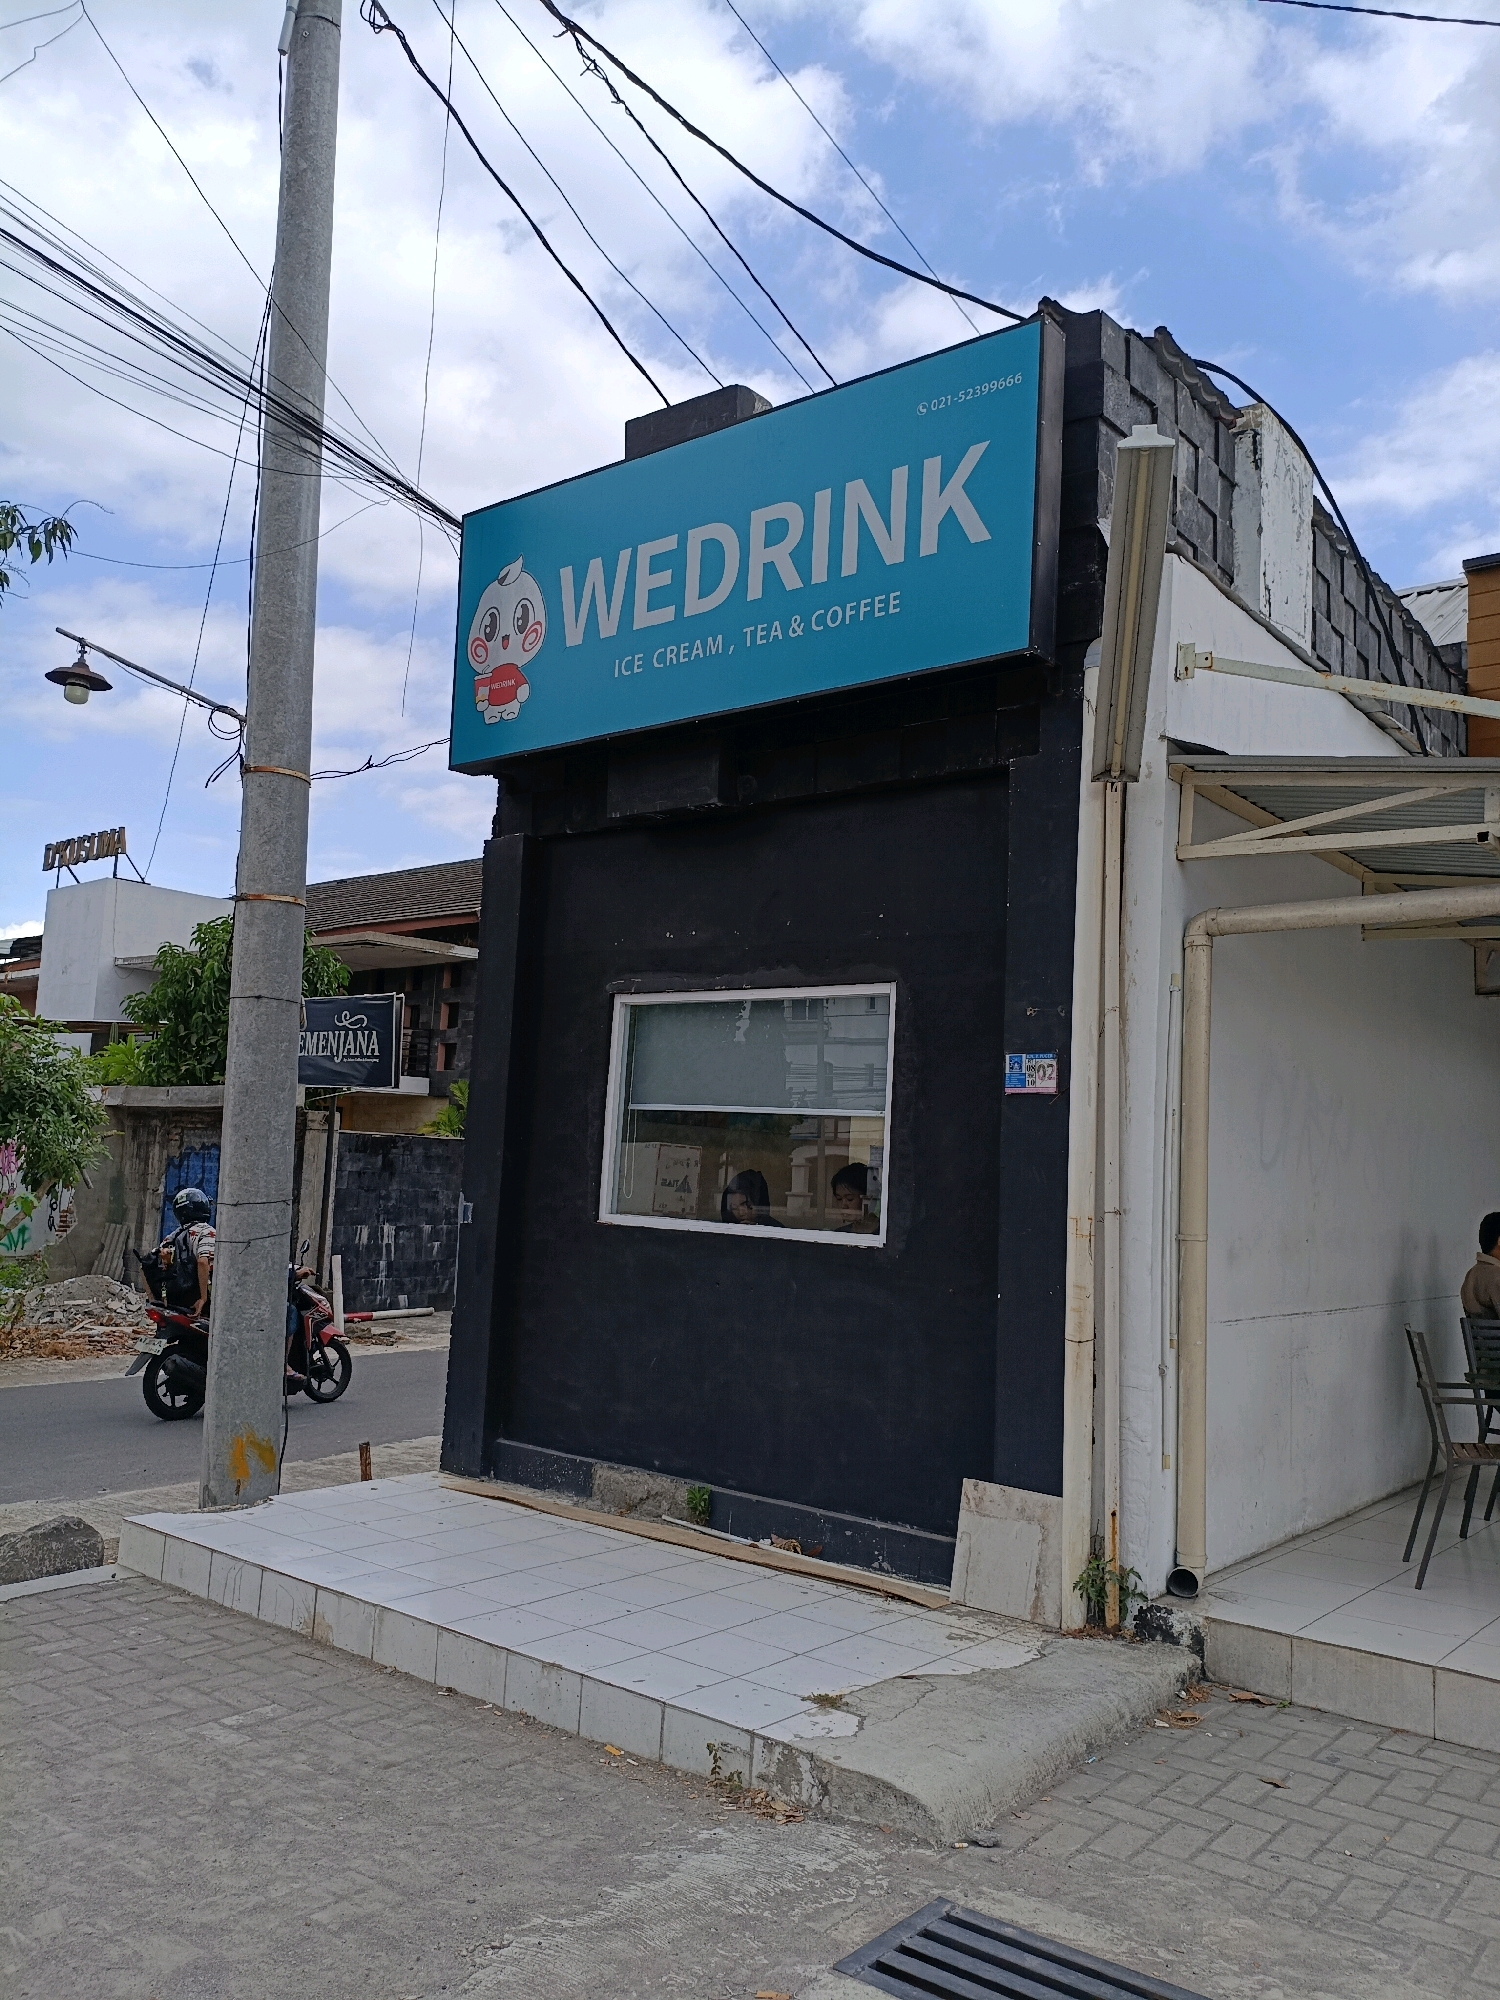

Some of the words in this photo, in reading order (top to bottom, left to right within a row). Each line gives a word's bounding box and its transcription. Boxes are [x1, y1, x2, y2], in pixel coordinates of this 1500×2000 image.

[931, 372, 1022, 411] 021-52399666
[559, 440, 992, 648] WEDRINK
[614, 654, 644, 678] ICE
[743, 621, 783, 647] TEA
[788, 614, 804, 638] &
[811, 591, 900, 631] COFFEE
[490, 678, 516, 690] WEDRINK
